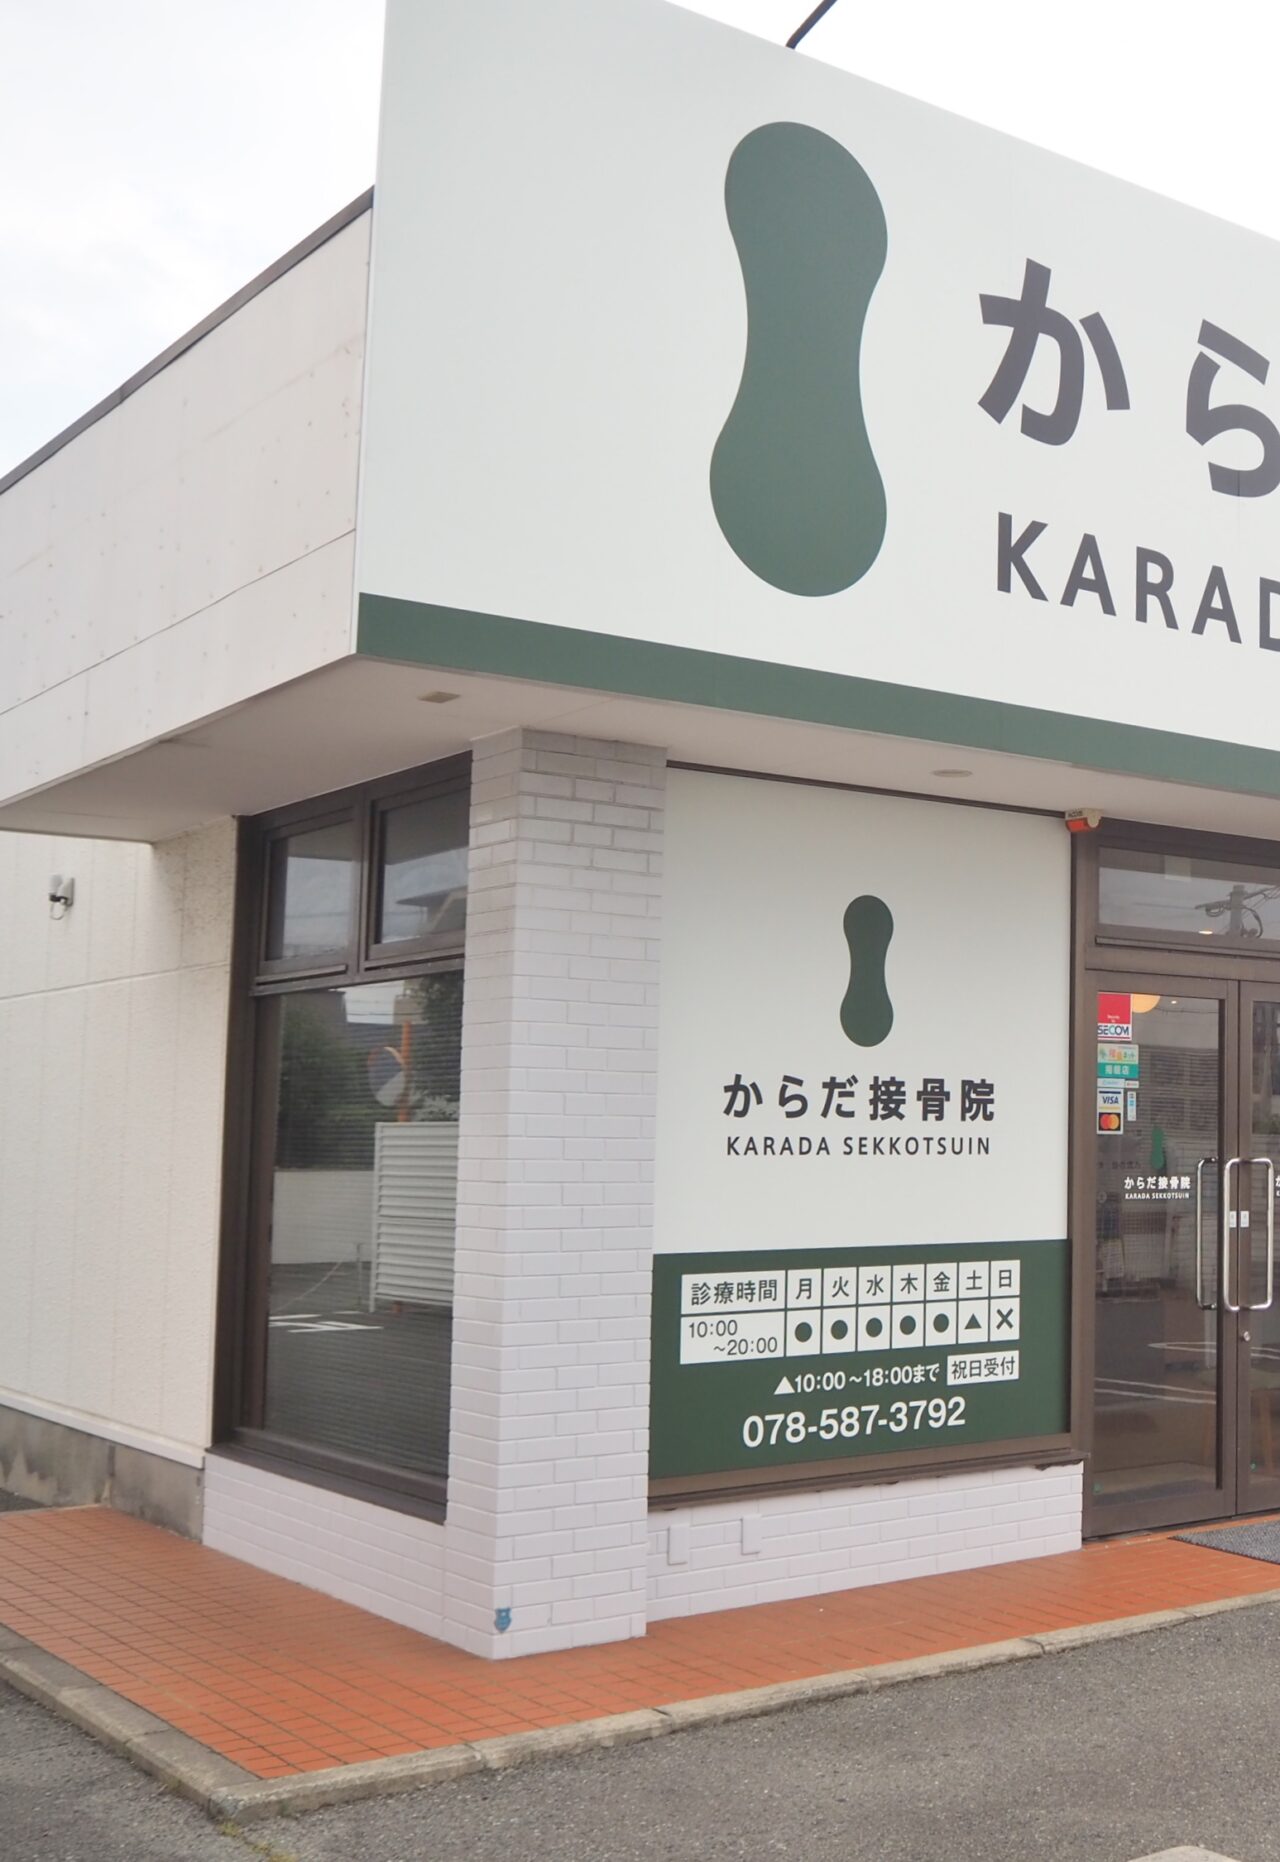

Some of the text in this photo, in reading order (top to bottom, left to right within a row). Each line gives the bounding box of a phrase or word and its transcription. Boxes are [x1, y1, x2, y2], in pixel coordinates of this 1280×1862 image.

[1097, 1025, 1130, 1036] SECOM
[723, 1072, 996, 1123] からだ接骨院
[1102, 1096, 1119, 1104] VISA
[726, 1135, 991, 1157] KARADA SEKKOTSUIN
[1123, 1175, 1191, 1190] からだ接骨院
[1125, 1192, 1190, 1200] KARADA SEKKOTSUIN
[690, 1269, 1013, 1306] 診療時間 月 火 水 木 金 土 日
[688, 1319, 738, 1339] 10:00
[951, 1355, 1017, 1380] 祝日受付
[742, 1396, 967, 1448] 078-587-3792
